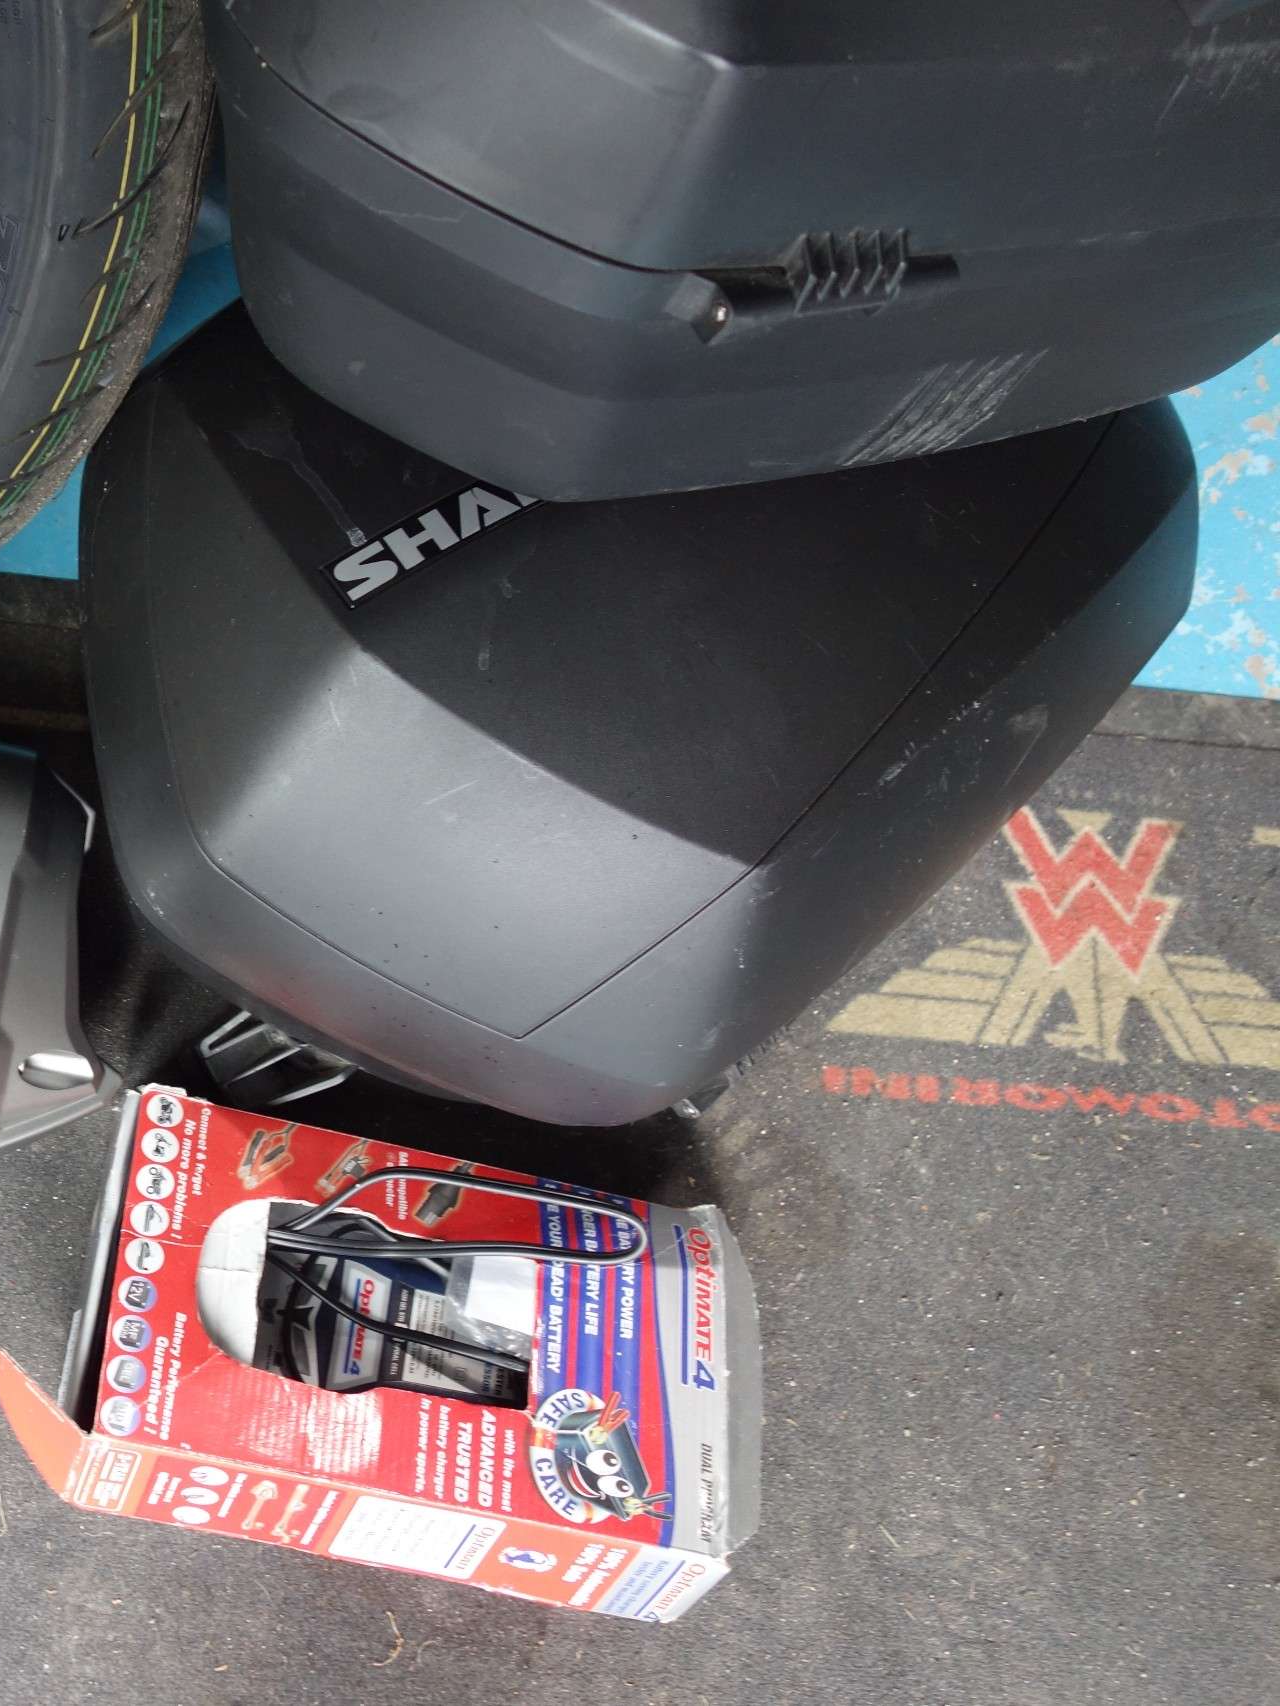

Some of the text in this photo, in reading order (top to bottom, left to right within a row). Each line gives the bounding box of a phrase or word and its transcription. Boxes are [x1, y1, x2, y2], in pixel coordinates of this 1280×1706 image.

[333, 486, 542, 601] SHA
[180, 1138, 193, 1169] more
[185, 1119, 196, 1135] No
[197, 1107, 211, 1150] Connect
[171, 1172, 188, 1230] problems
[192, 1163, 206, 1196] forget
[396, 1178, 408, 1220] mpatible
[547, 1216, 562, 1248] YOUR
[580, 1192, 599, 1336] NGER BATERY LIFE
[129, 1282, 145, 1301] 12V
[620, 1287, 634, 1338] POWER
[546, 1305, 564, 1374] BATTERY
[145, 1336, 169, 1424] Guaranteed
[160, 1312, 187, 1440] Battery Performance
[418, 1411, 429, 1451] power
[540, 1393, 586, 1428] SAFE
[433, 1405, 451, 1499] battery charger
[454, 1422, 473, 1503] TRUSTED
[478, 1410, 496, 1508] ADVANCED
[501, 1429, 515, 1512] with the most
[701, 1443, 713, 1474] DUAL
[535, 1458, 579, 1516] CARE
